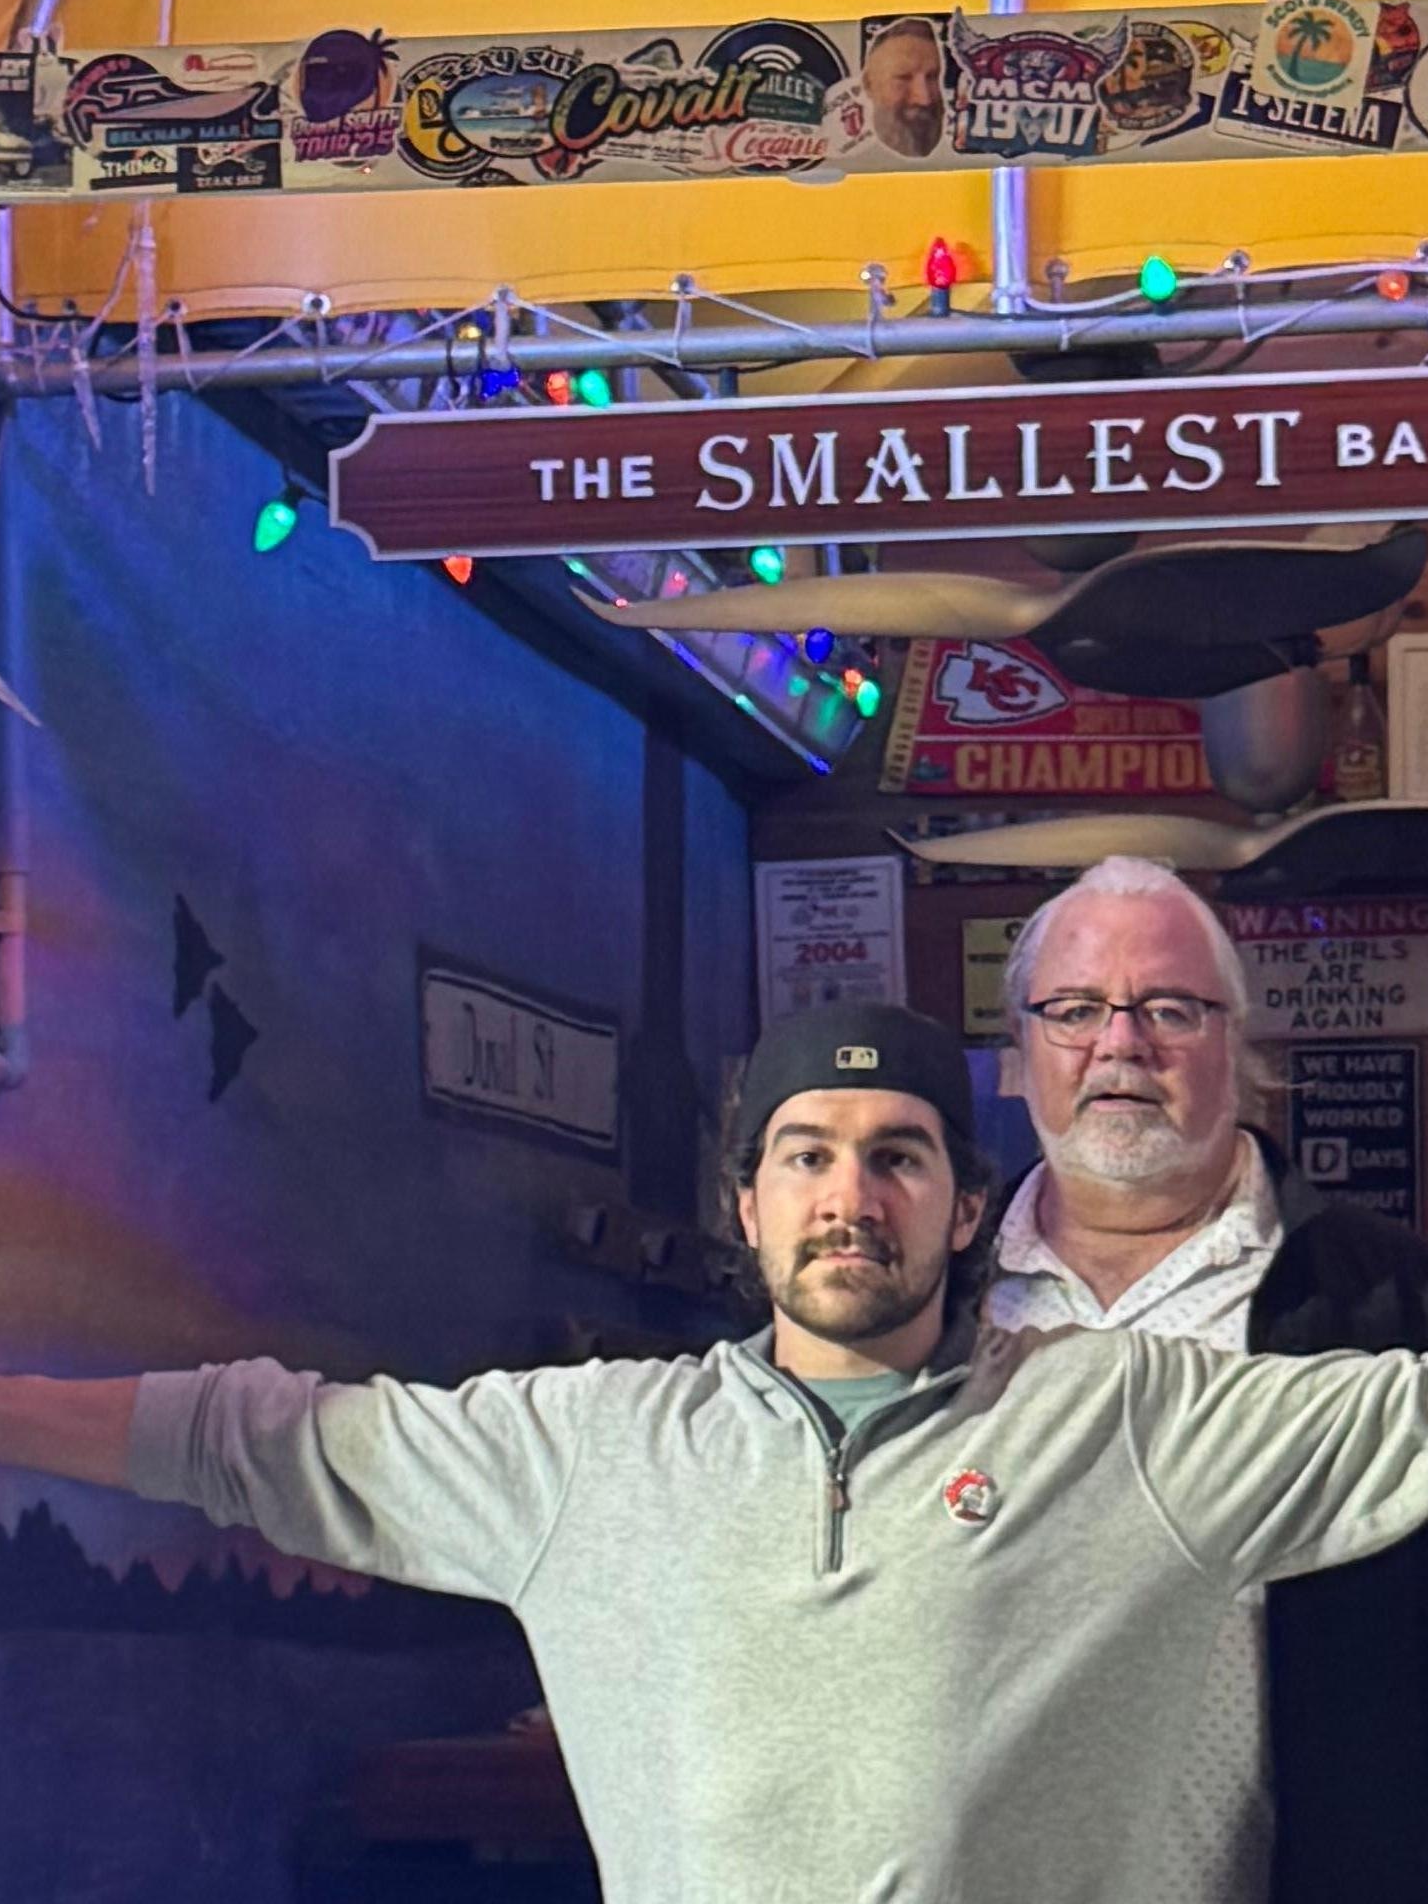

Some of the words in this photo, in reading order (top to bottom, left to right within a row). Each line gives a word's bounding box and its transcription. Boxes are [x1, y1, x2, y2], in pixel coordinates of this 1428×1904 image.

[972, 78, 1093, 102] MCM
[340, 108, 400, 132] SOUTH
[1273, 94, 1381, 144] SELENA
[295, 133, 349, 161] TOUR
[529, 457, 656, 501] THE
[692, 409, 1303, 513] SMALLEST
[954, 741, 1214, 792] CHAMPIO
[793, 941, 869, 966] 2004
[1253, 942, 1310, 965] THE
[1321, 938, 1411, 963] GIRLS
[1304, 963, 1366, 985] ARE
[1266, 984, 1407, 1010] DRINKING
[1290, 1009, 1385, 1031] AGAIN
[1302, 1055, 1340, 1075] WE
[1344, 1053, 1404, 1074] HAVE
[1302, 1107, 1404, 1128] WORKED
